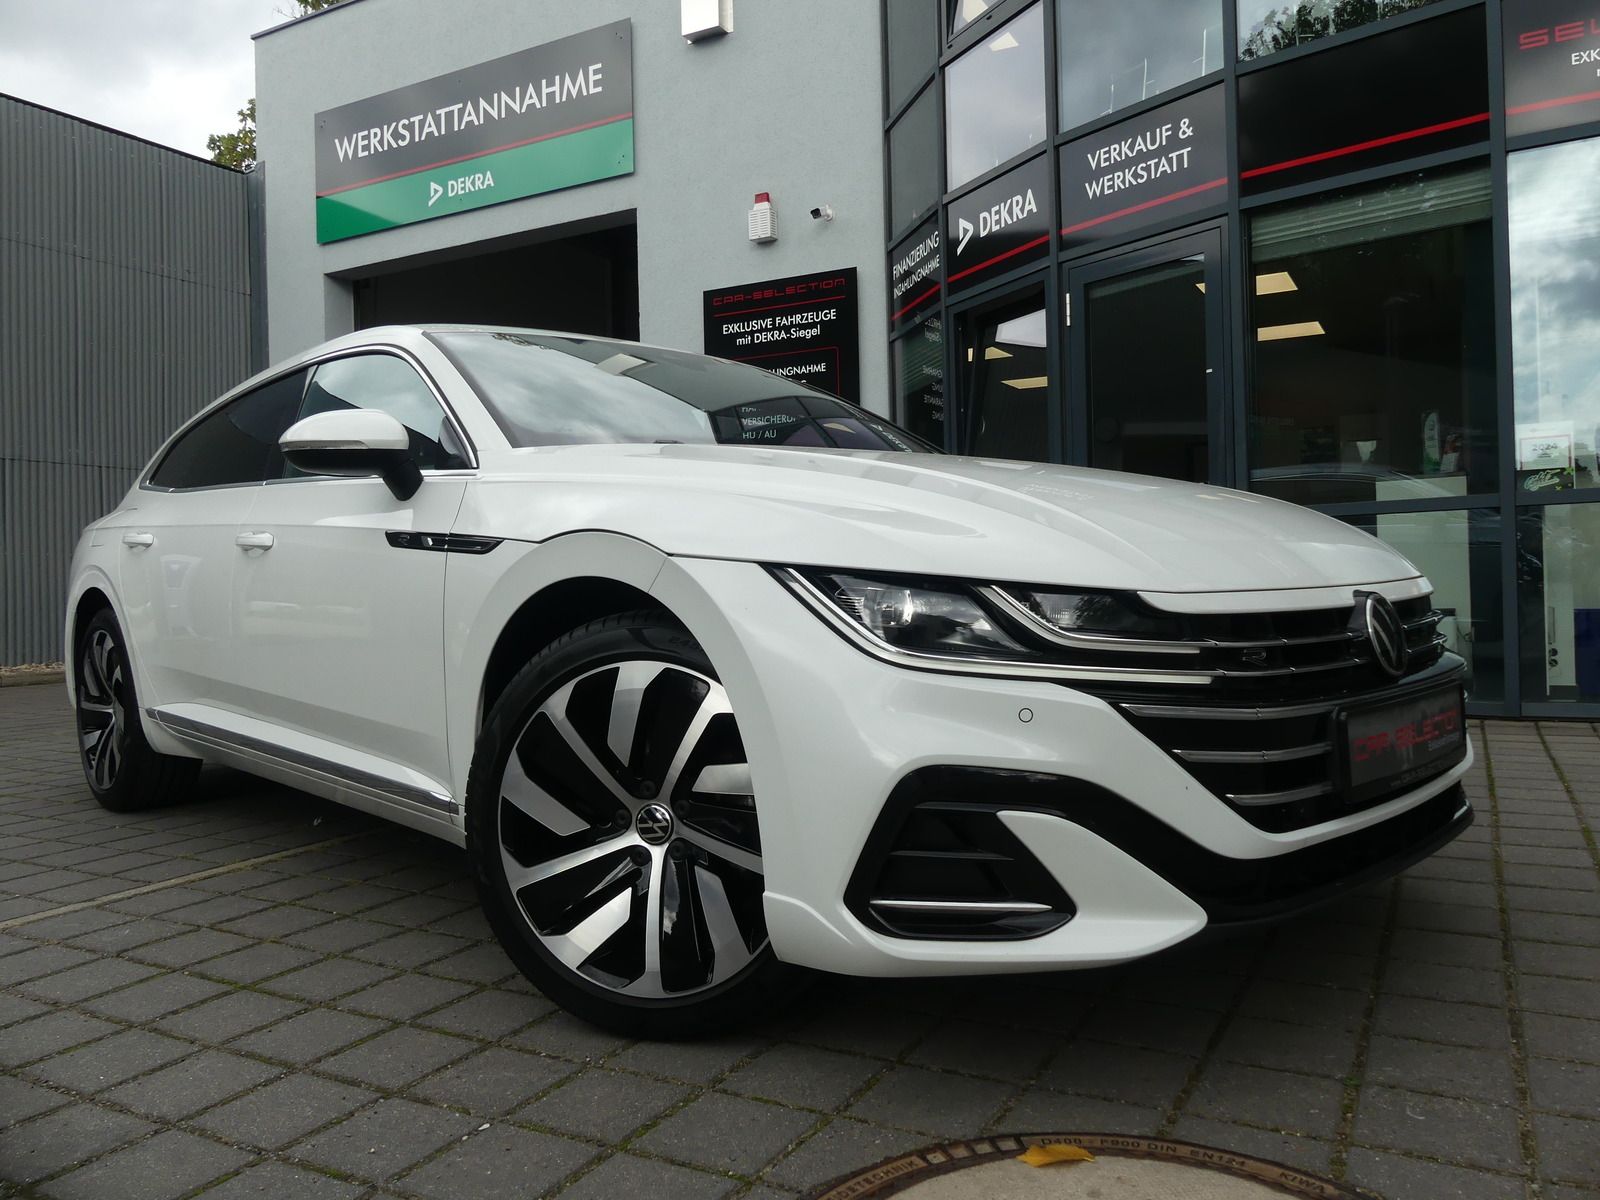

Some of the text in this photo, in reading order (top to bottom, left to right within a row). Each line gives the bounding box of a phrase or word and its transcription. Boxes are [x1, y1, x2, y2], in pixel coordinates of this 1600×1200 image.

[334, 62, 603, 163] WERKSTATTANNAHME
[1087, 118, 1194, 171] VERKAUF &
[447, 170, 495, 198] DEKRA
[1085, 147, 1192, 200] WERKSTATT
[979, 188, 1037, 238] DEKRA
[892, 230, 940, 281] FINANZIERUNG
[712, 278, 846, 306] CAR-SELECTION
[722, 308, 837, 335] EXKLUSIVE FAHRZEUGE
[736, 324, 821, 346] mit DEKRA-Siegel
[1147, 1143, 1178, 1154] DIN
